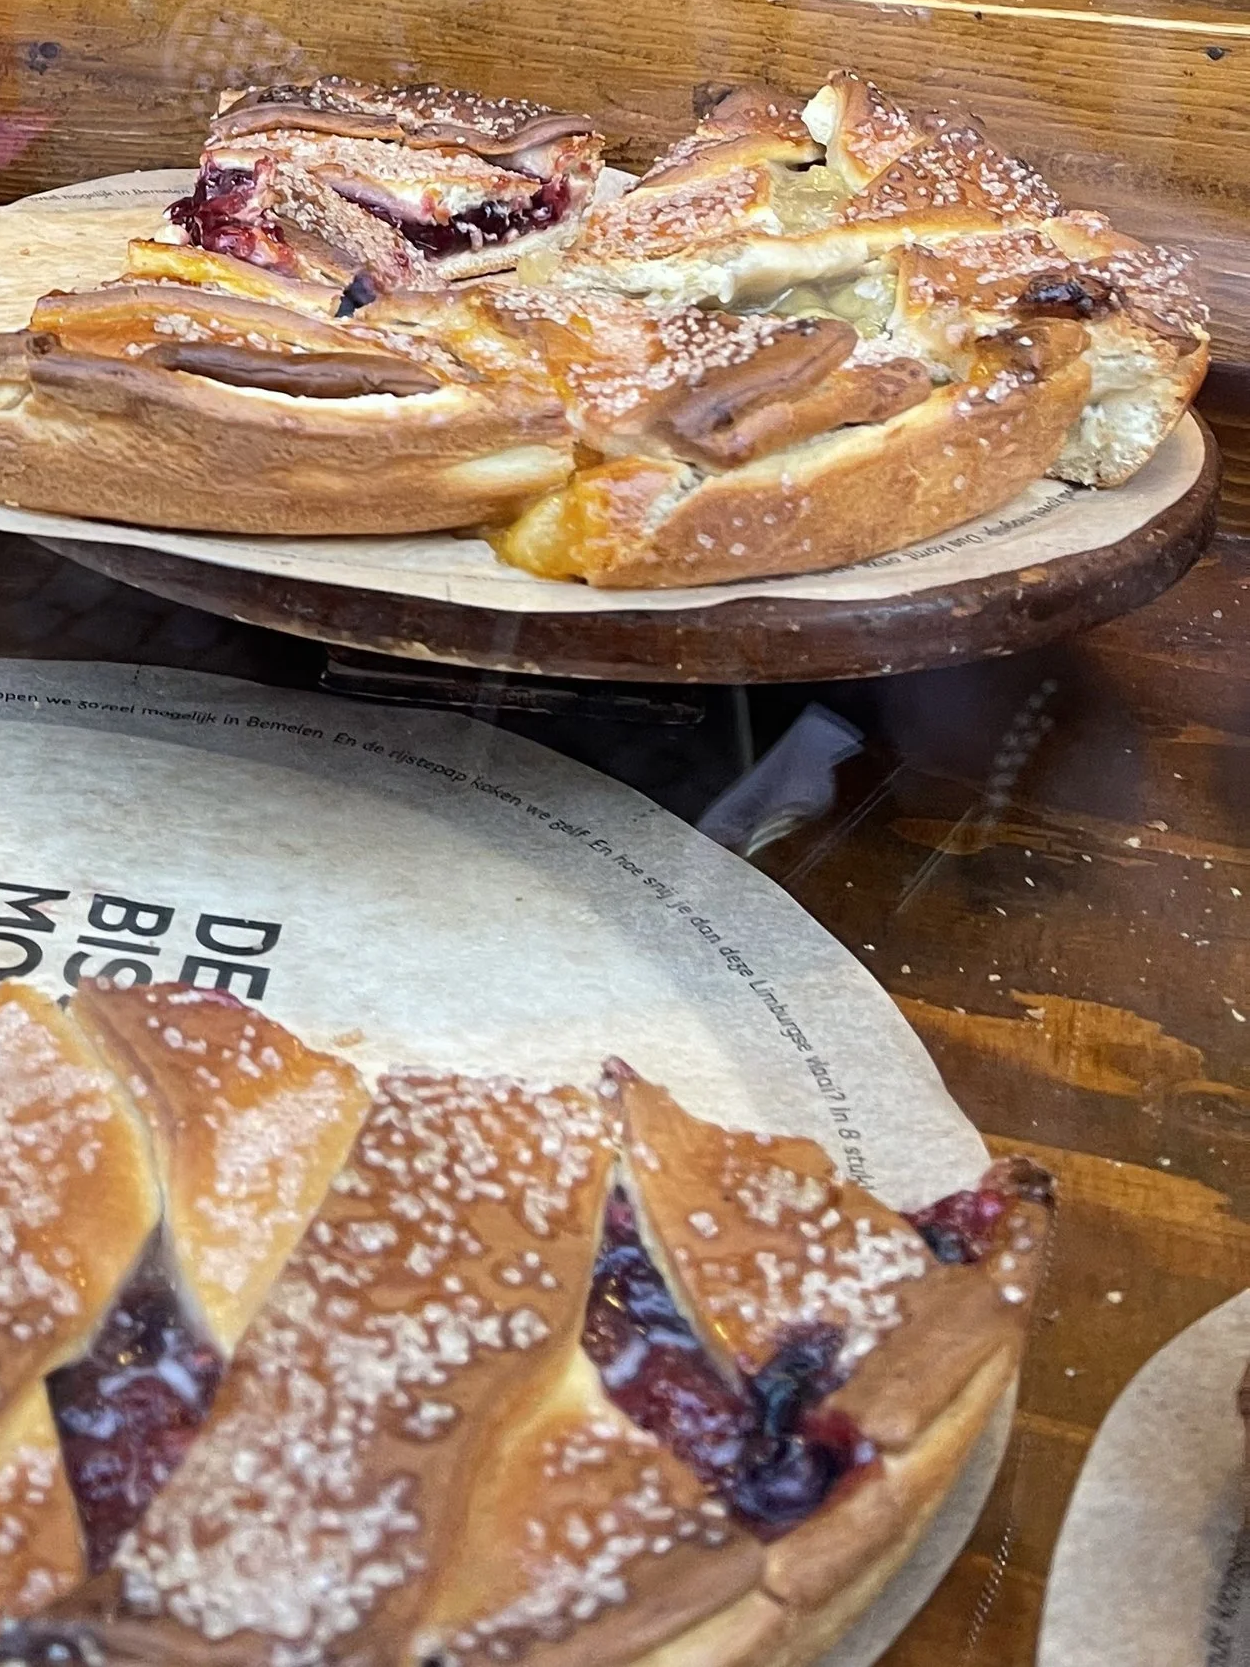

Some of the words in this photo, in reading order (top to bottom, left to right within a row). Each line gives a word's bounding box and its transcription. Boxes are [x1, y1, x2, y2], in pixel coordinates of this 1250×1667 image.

[46, 696, 72, 707] we
[141, 706, 218, 726] mogelijk
[222, 712, 240, 727] in
[333, 731, 357, 747] En
[362, 739, 386, 755] de
[388, 748, 469, 783] rijstepap
[469, 774, 524, 809] koken
[525, 802, 552, 822] we
[588, 838, 613, 858] En
[612, 853, 645, 878] hoe
[642, 876, 682, 902] snij
[665, 898, 693, 916] je
[689, 915, 722, 945] dan
[718, 945, 755, 979] deze
[748, 979, 814, 1054] Limburgse
[805, 1054, 847, 1103] vlaai?
[838, 1127, 862, 1141] 8
[63, 892, 176, 1009] BIS
[178, 911, 283, 1004] DE
